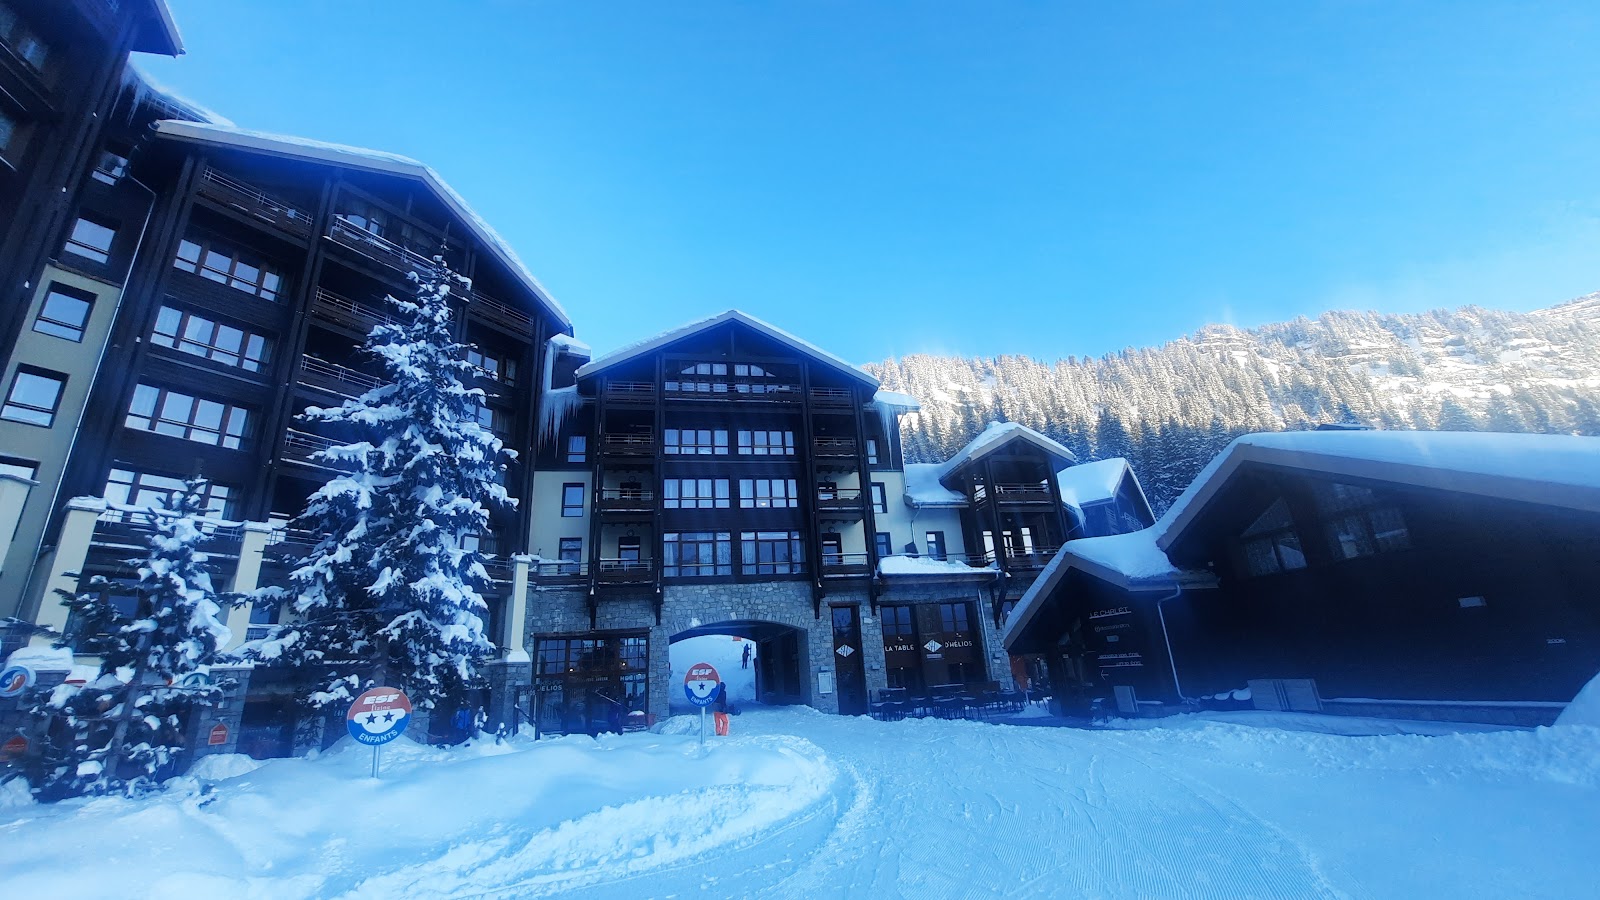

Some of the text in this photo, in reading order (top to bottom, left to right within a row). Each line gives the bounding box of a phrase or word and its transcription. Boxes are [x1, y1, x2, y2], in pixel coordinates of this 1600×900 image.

[691, 668, 713, 676] ESF
[363, 694, 400, 705] ESF
[690, 696, 713, 705] ENFANTS
[358, 729, 398, 743] ENFANTS
